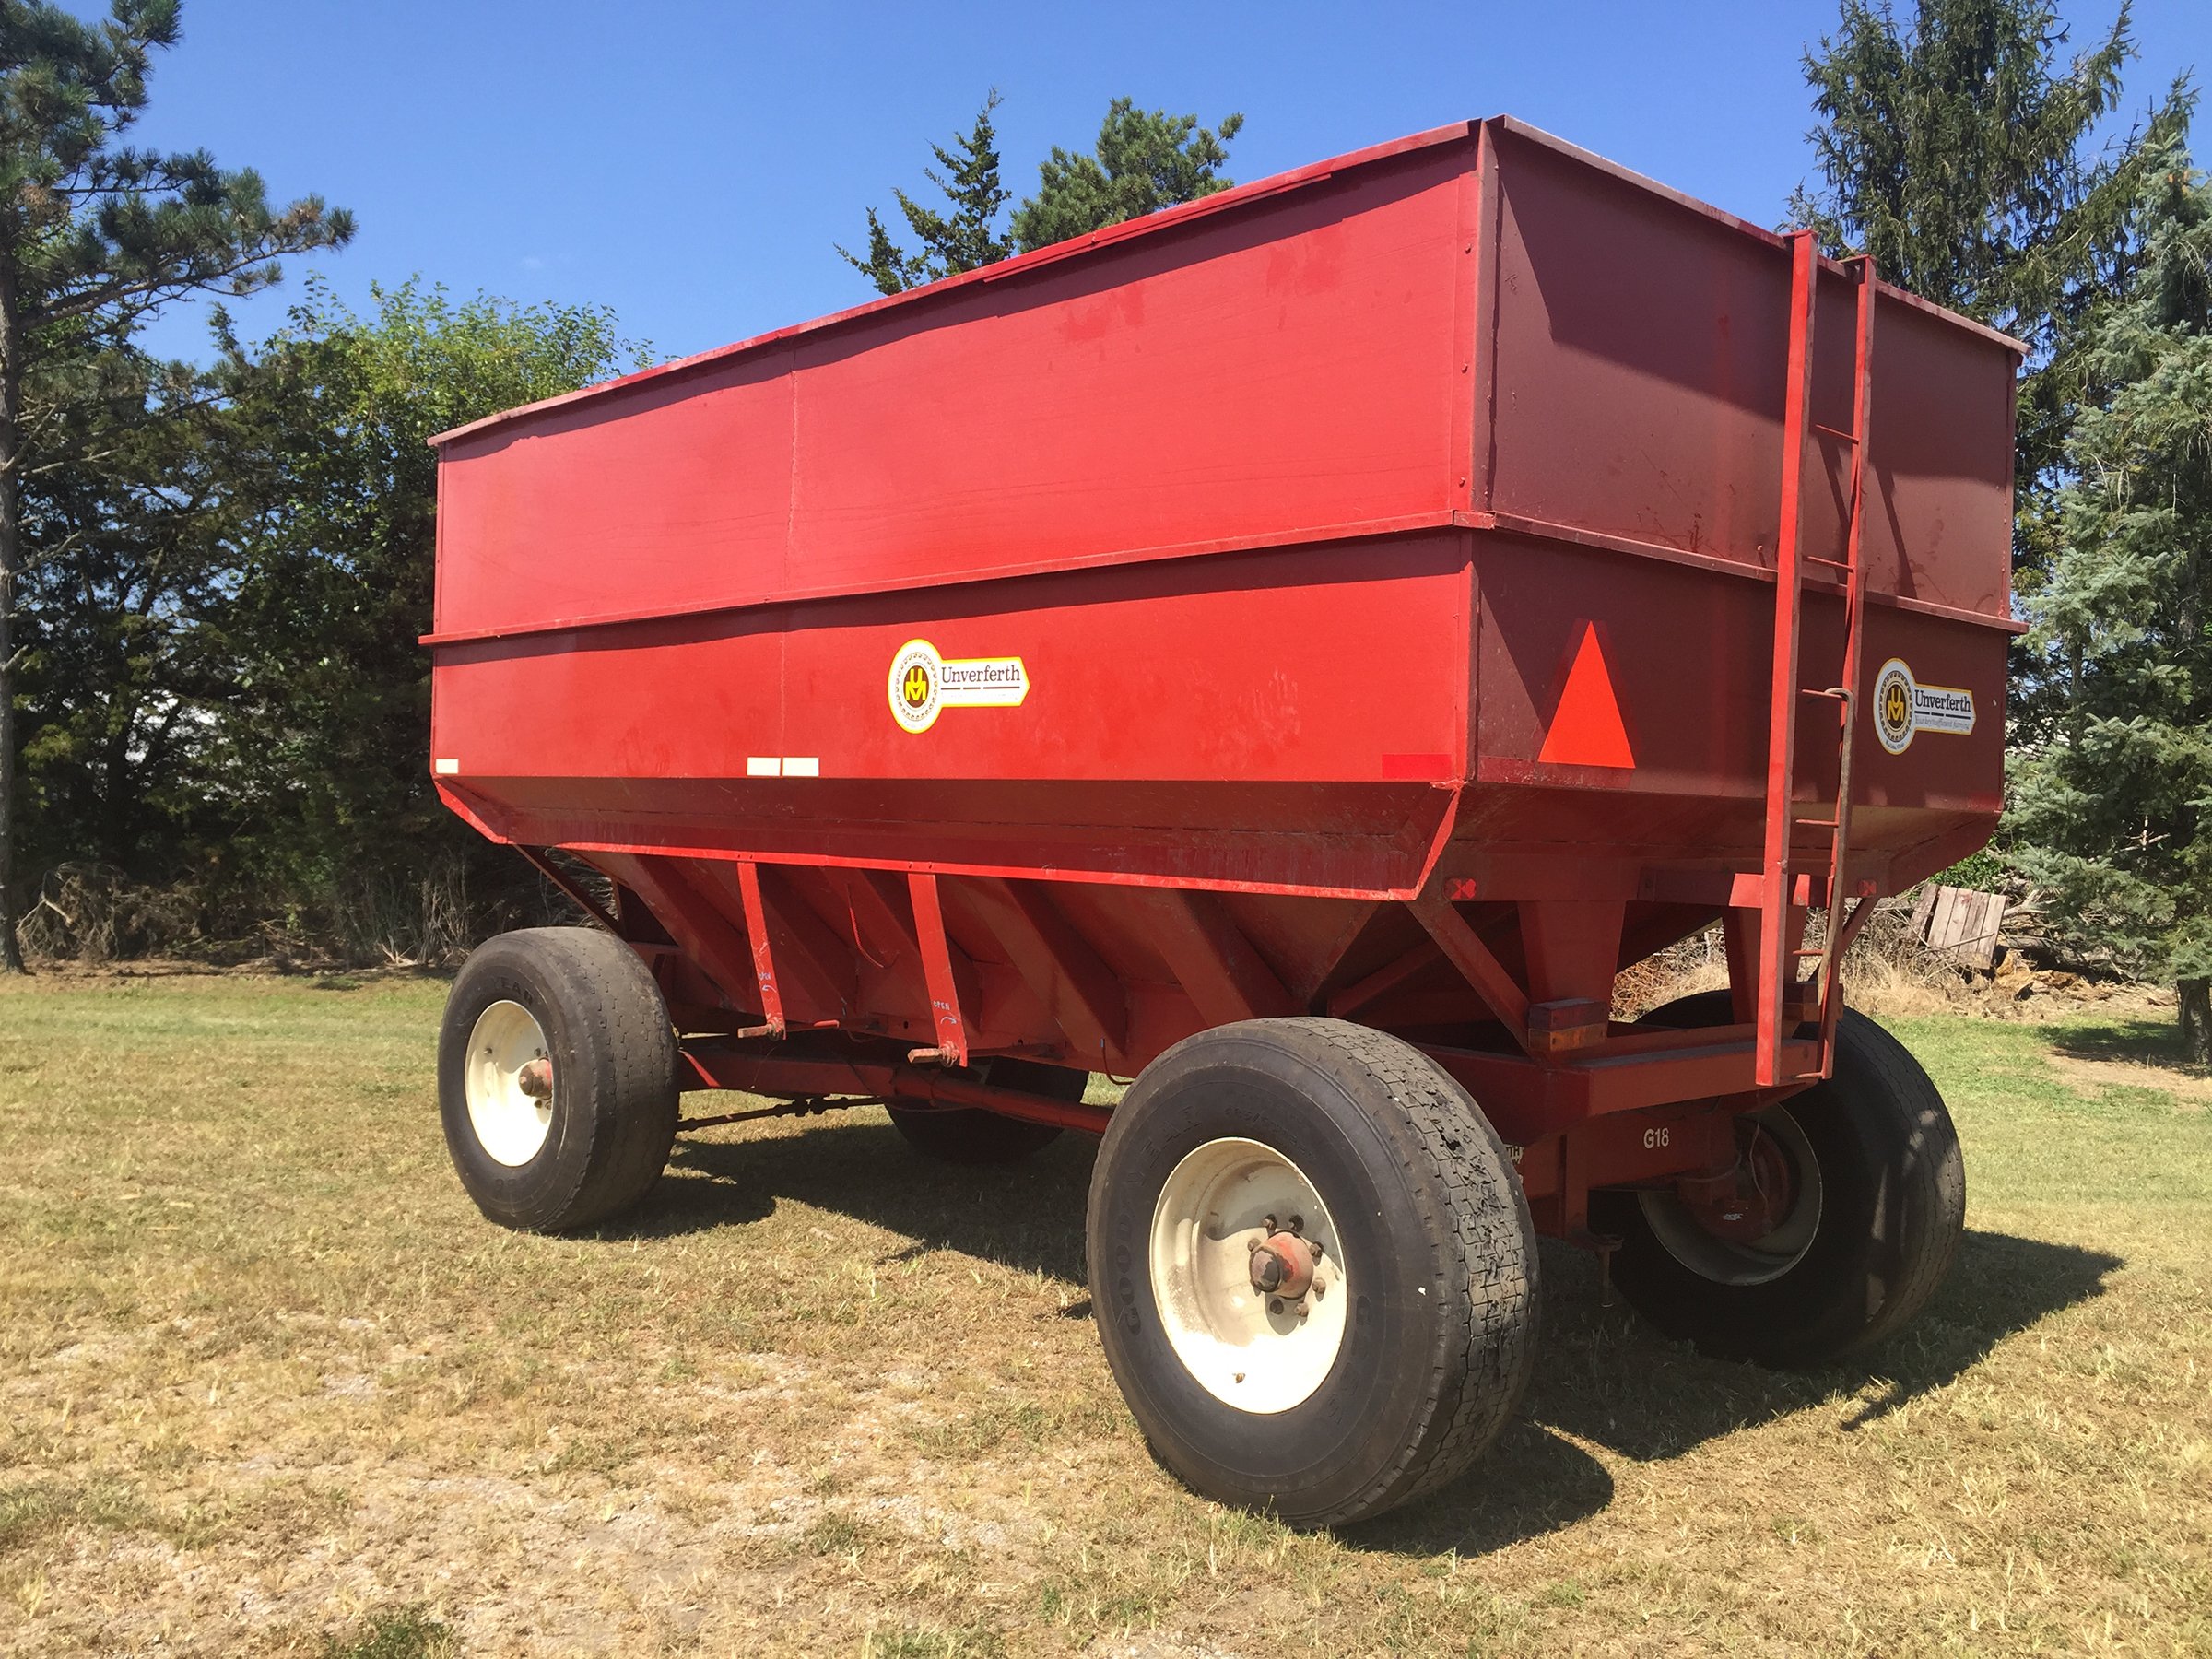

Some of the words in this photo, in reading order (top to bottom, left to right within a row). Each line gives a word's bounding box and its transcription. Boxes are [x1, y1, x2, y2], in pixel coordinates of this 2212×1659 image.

[941, 665, 1020, 683] Unverferth
[1914, 689, 1971, 712] Unverferth
[1643, 1127, 1670, 1149] G18
